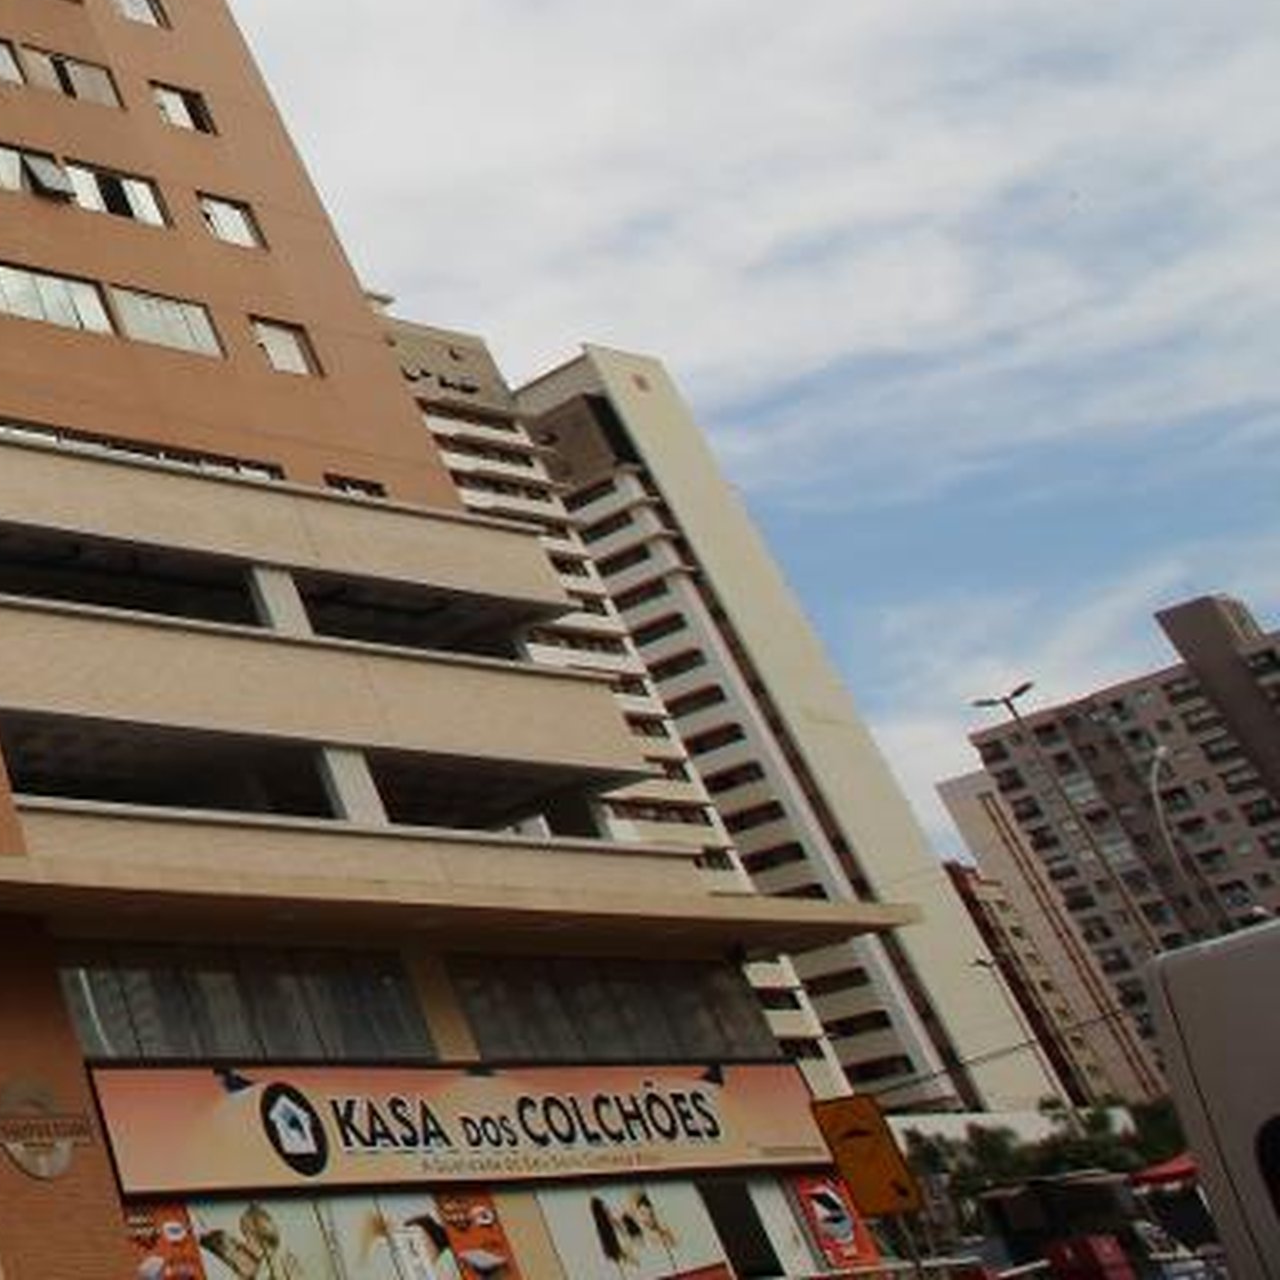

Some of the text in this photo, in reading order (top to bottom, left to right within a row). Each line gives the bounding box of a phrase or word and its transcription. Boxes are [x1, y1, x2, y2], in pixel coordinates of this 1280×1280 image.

[331, 1080, 721, 1148] KASA DOS COLCHÕES
